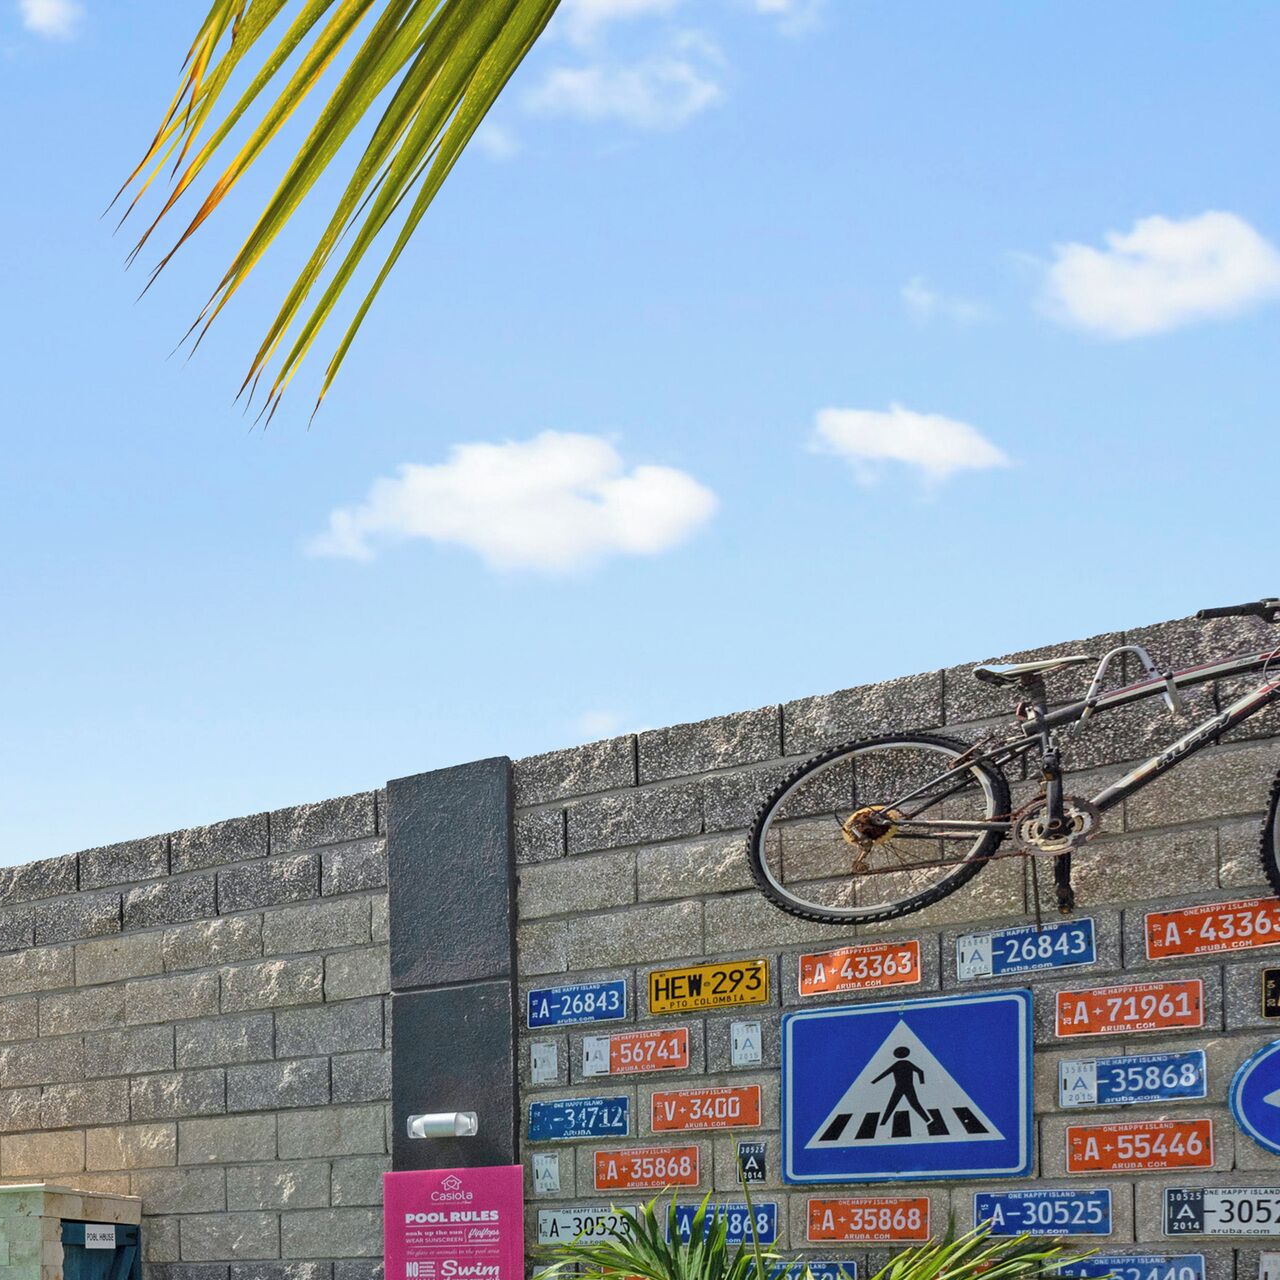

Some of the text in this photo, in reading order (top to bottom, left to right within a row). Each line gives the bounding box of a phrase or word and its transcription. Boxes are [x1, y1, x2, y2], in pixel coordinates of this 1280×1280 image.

[1200, 906, 1226, 914] HAPPY
[1228, 901, 1259, 910] ISLAND
[1007, 928, 1030, 937] HAPPY
[1194, 940, 1252, 952] ARUBA.COM
[969, 949, 984, 963] A
[1001, 962, 1053, 973] aruba.com
[1108, 987, 1133, 995] HAPPY
[1134, 984, 1163, 993] ISLAND
[539, 991, 619, 1018] A-26843
[670, 995, 744, 1009] PTO COLOMBIA
[557, 1016, 594, 1024] aruba.com
[1100, 1022, 1156, 1032] ARUBA.COM
[1112, 1058, 1137, 1066] HAPPY
[1072, 1076, 1088, 1091] A
[1105, 1094, 1160, 1103] aruba.com
[1118, 1124, 1143, 1132] HAPPY
[745, 1156, 759, 1169] A
[431, 1191, 473, 1201] Casiola
[1170, 1192, 1202, 1201] 30525
[405, 1210, 499, 1224] POOL RULES
[992, 1200, 1102, 1226] A-30525
[1176, 1204, 1195, 1219] A
[1173, 1222, 1200, 1230] 2014
[406, 1261, 418, 1277] NO
[441, 1260, 499, 1276] Swim
